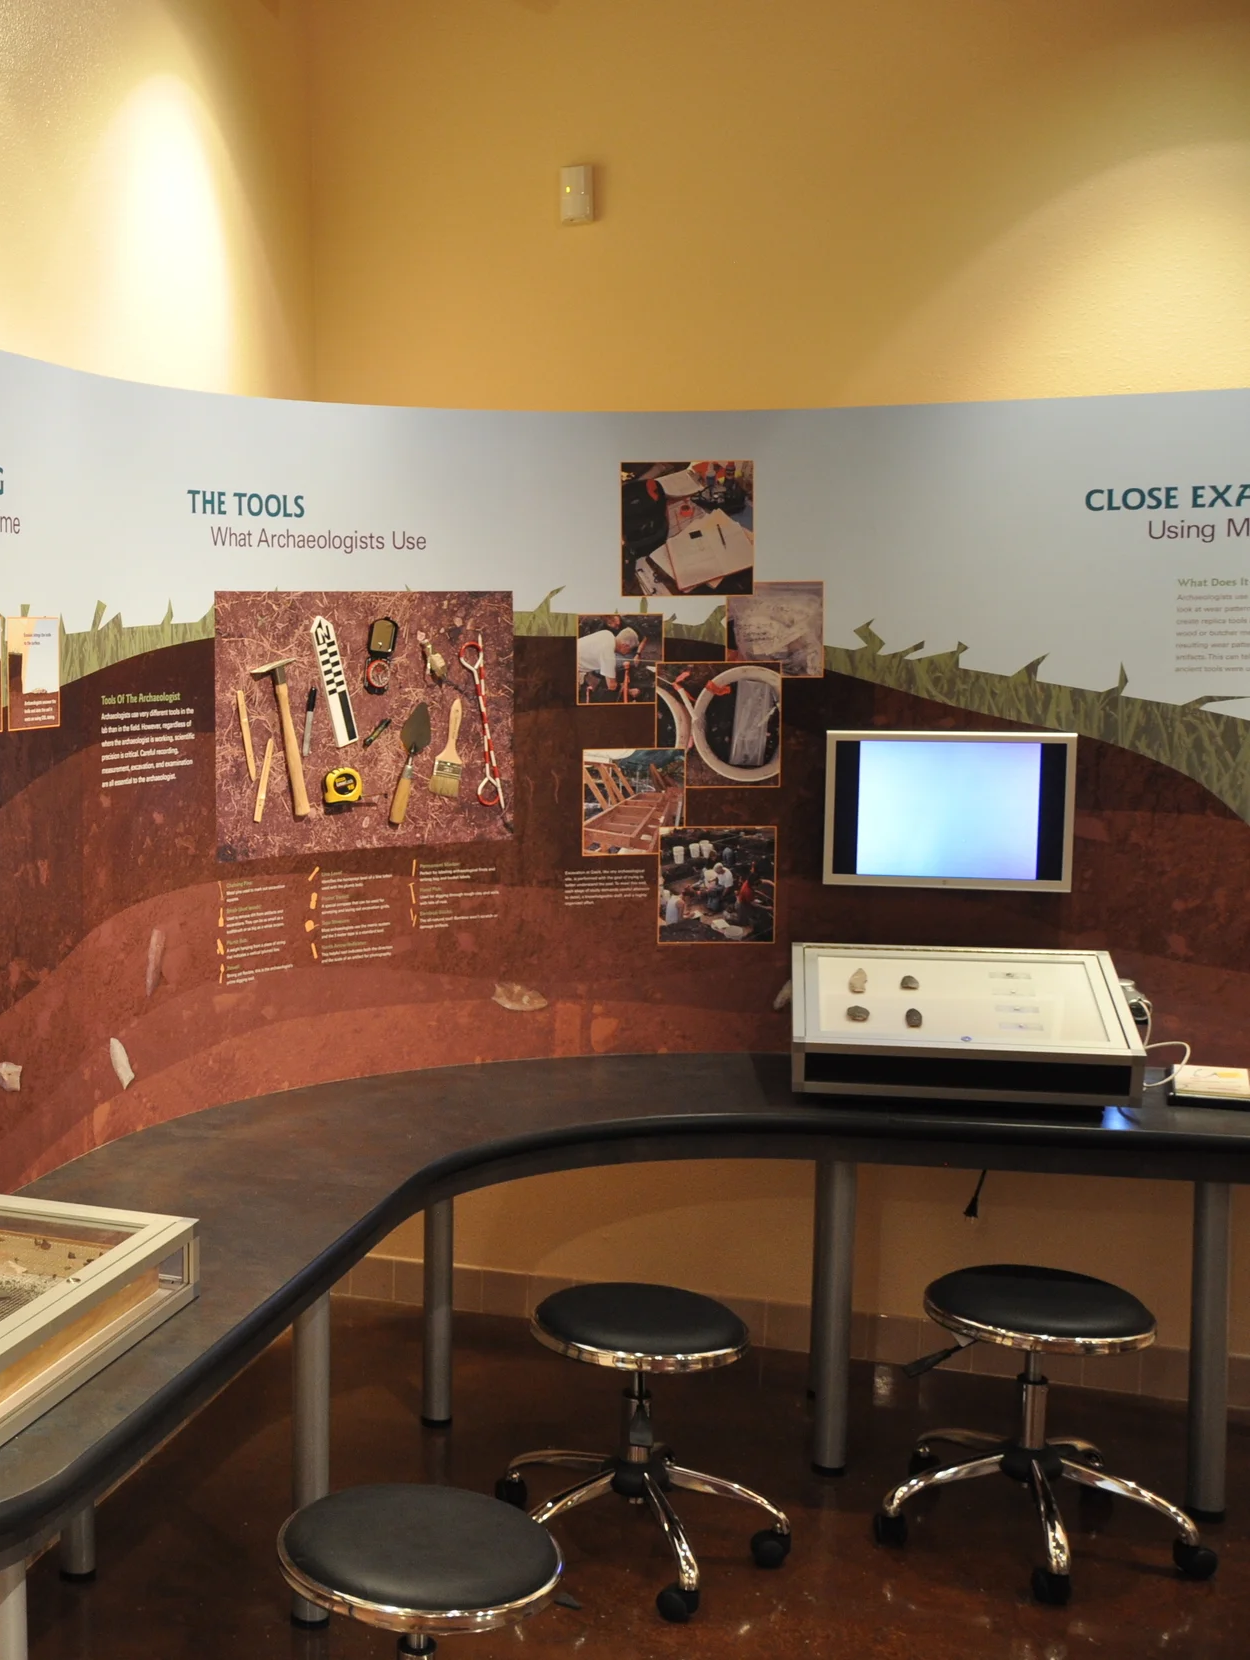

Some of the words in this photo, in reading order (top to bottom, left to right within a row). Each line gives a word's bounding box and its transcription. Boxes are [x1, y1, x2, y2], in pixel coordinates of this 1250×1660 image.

[187, 490, 227, 515] THE
[233, 493, 305, 518] TOOLS
[1085, 487, 1179, 511] CLOSE
[210, 526, 253, 547] What
[257, 529, 385, 554] Archaeologists
[392, 531, 427, 550] Use
[1148, 520, 1215, 543] Using
[1177, 578, 1208, 587] What
[1211, 578, 1237, 587] Does
[1240, 577, 1250, 586] It
[101, 695, 116, 705] Tools
[117, 694, 125, 704] Of
[125, 693, 138, 703] The
[138, 692, 181, 703] Archaeologist
